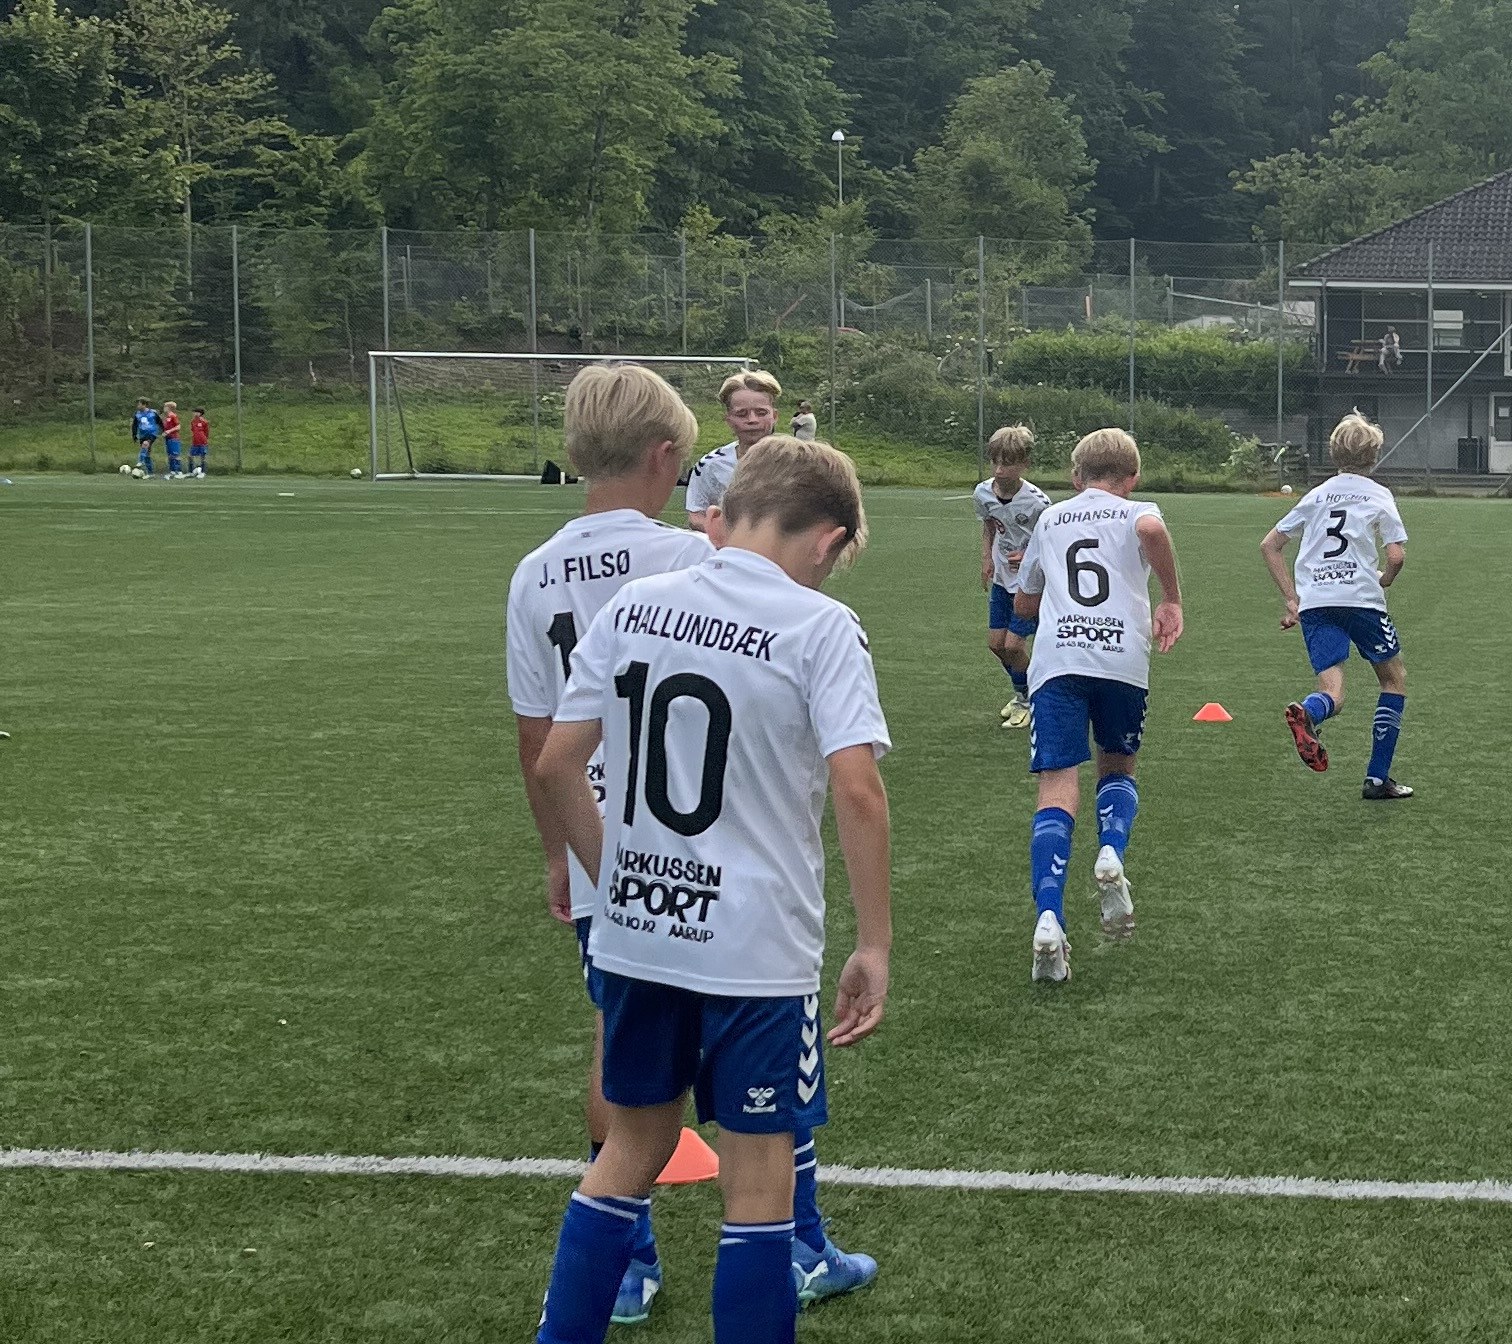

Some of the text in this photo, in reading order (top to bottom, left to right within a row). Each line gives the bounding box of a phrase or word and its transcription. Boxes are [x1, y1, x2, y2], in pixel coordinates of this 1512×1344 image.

[1054, 509, 1130, 526] JOHANSEN
[1323, 509, 1349, 559] 3
[539, 548, 630, 589] J. FILSØ
[1066, 538, 1110, 607] 6
[623, 604, 779, 661] HALLUNDBÆK
[1056, 624, 1125, 645] SPORT
[1057, 614, 1124, 629] MARKUSSEN
[614, 660, 733, 838] 10
[668, 923, 715, 944] AARUP
